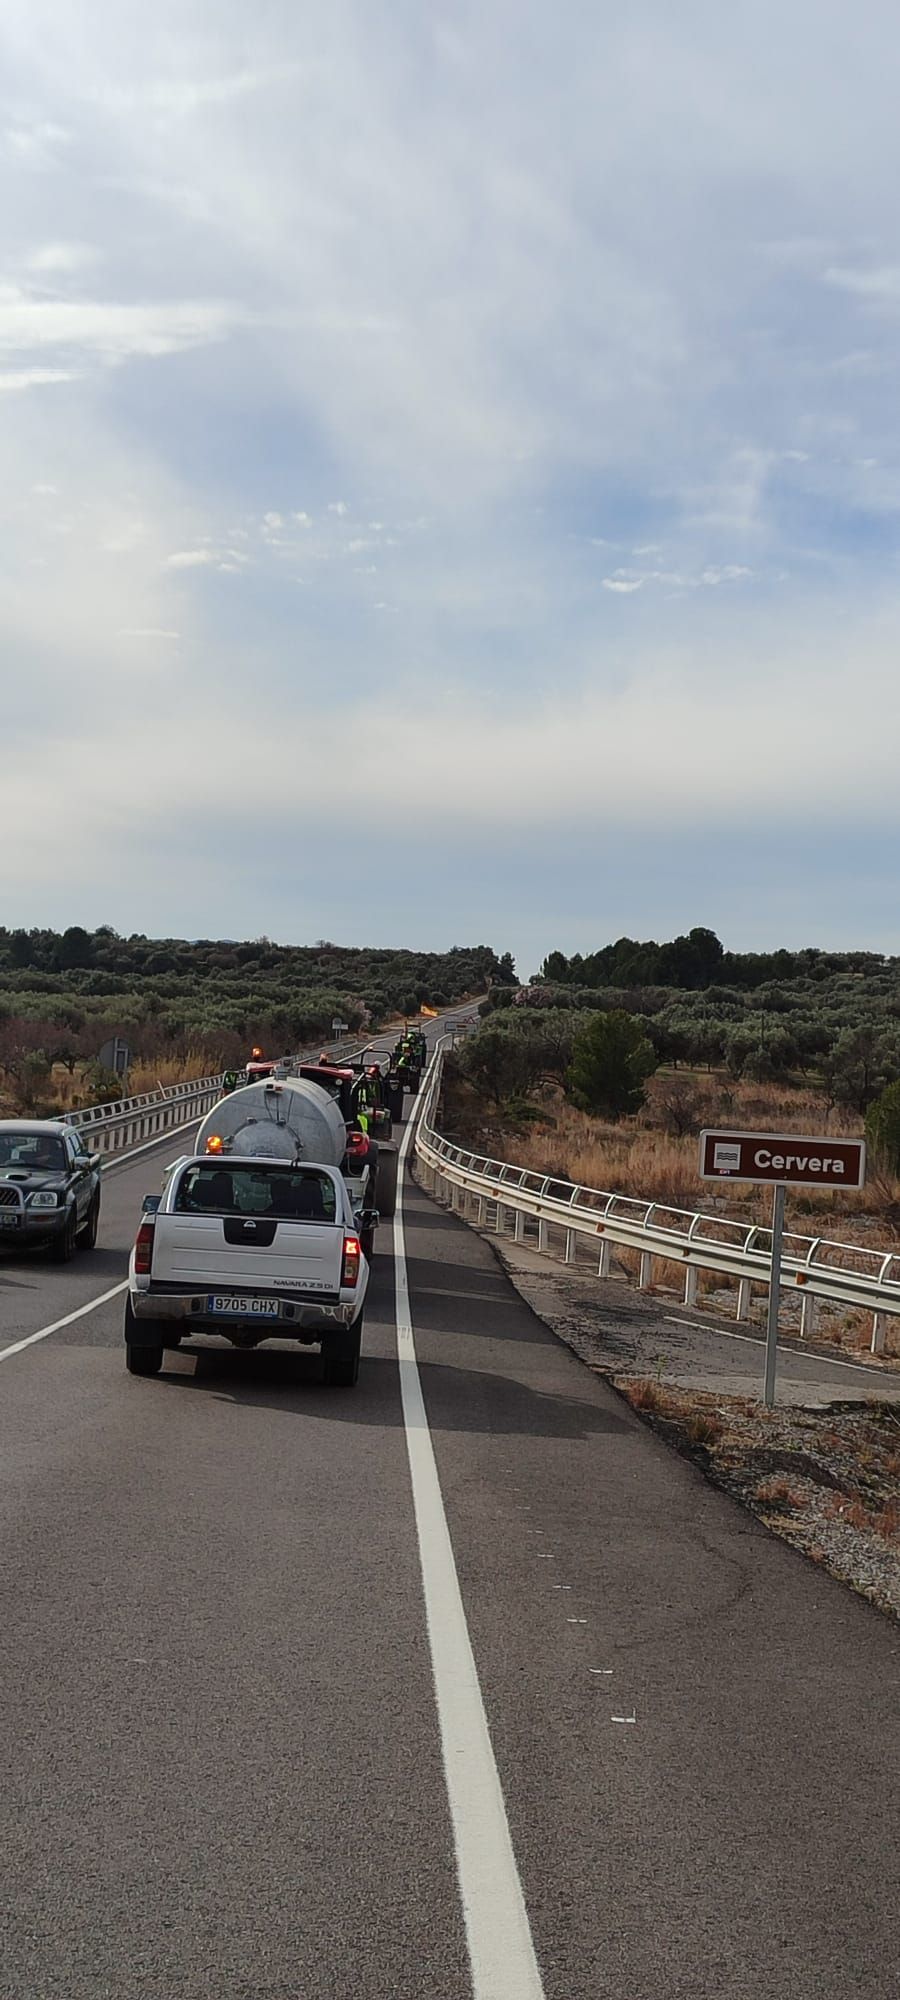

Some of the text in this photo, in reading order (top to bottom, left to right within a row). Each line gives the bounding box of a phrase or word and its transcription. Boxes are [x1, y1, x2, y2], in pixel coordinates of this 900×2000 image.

[754, 1149, 845, 1173] Cervera
[273, 1280, 308, 1288] NAVARA
[215, 1298, 275, 1313] 9705 CHX
